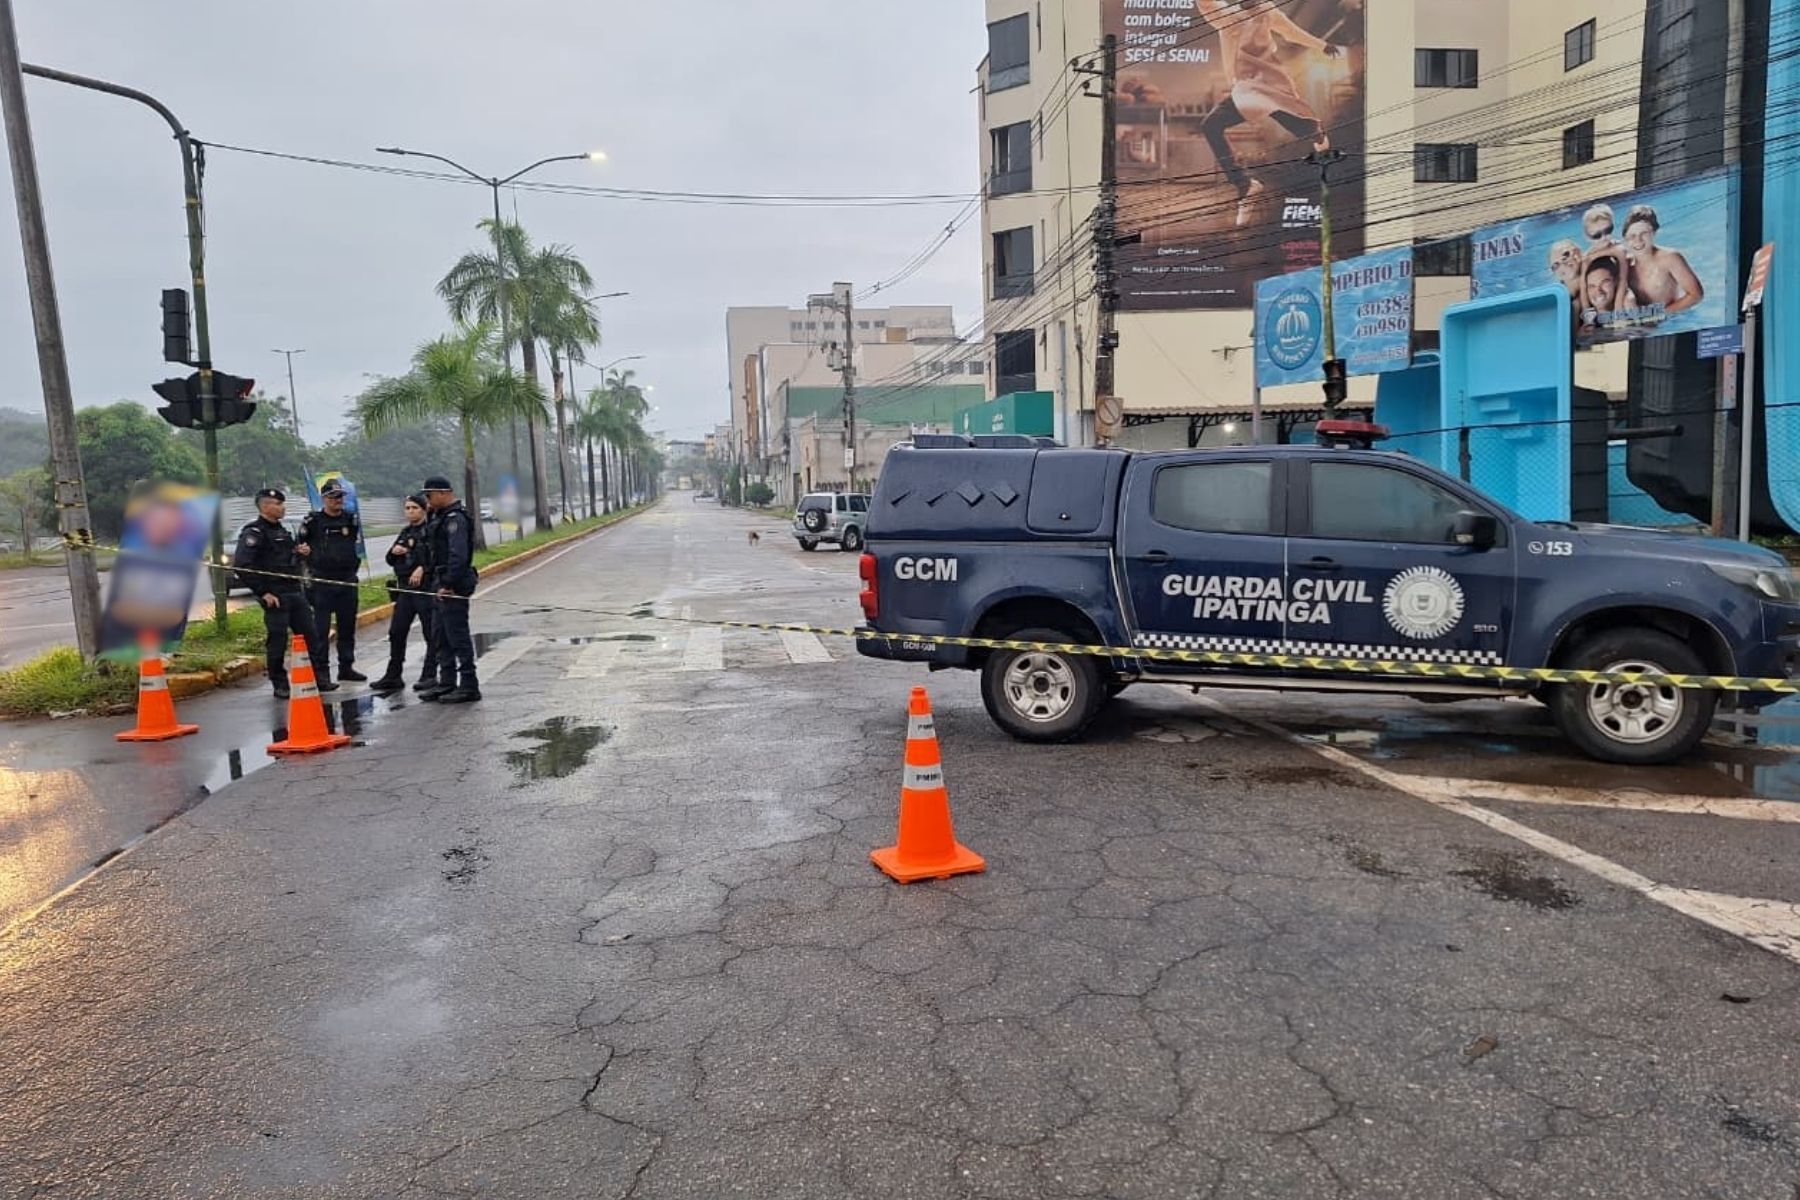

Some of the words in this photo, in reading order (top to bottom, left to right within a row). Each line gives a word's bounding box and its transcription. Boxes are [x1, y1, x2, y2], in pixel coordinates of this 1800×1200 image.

[1125, 14, 1152, 26] com
[1154, 12, 1192, 27] bolsa
[1124, 29, 1177, 47] integral
[1125, 48, 1154, 61] SESI
[1157, 52, 1166, 61] e
[1169, 48, 1210, 62] SENAI
[1331, 264, 1393, 291] MPERIO
[1546, 541, 1573, 556] 153
[894, 556, 958, 581] GCM
[1162, 574, 1283, 600] GUARDA
[1292, 578, 1374, 603] CIVIL
[1193, 597, 1331, 624] IPATINGA
